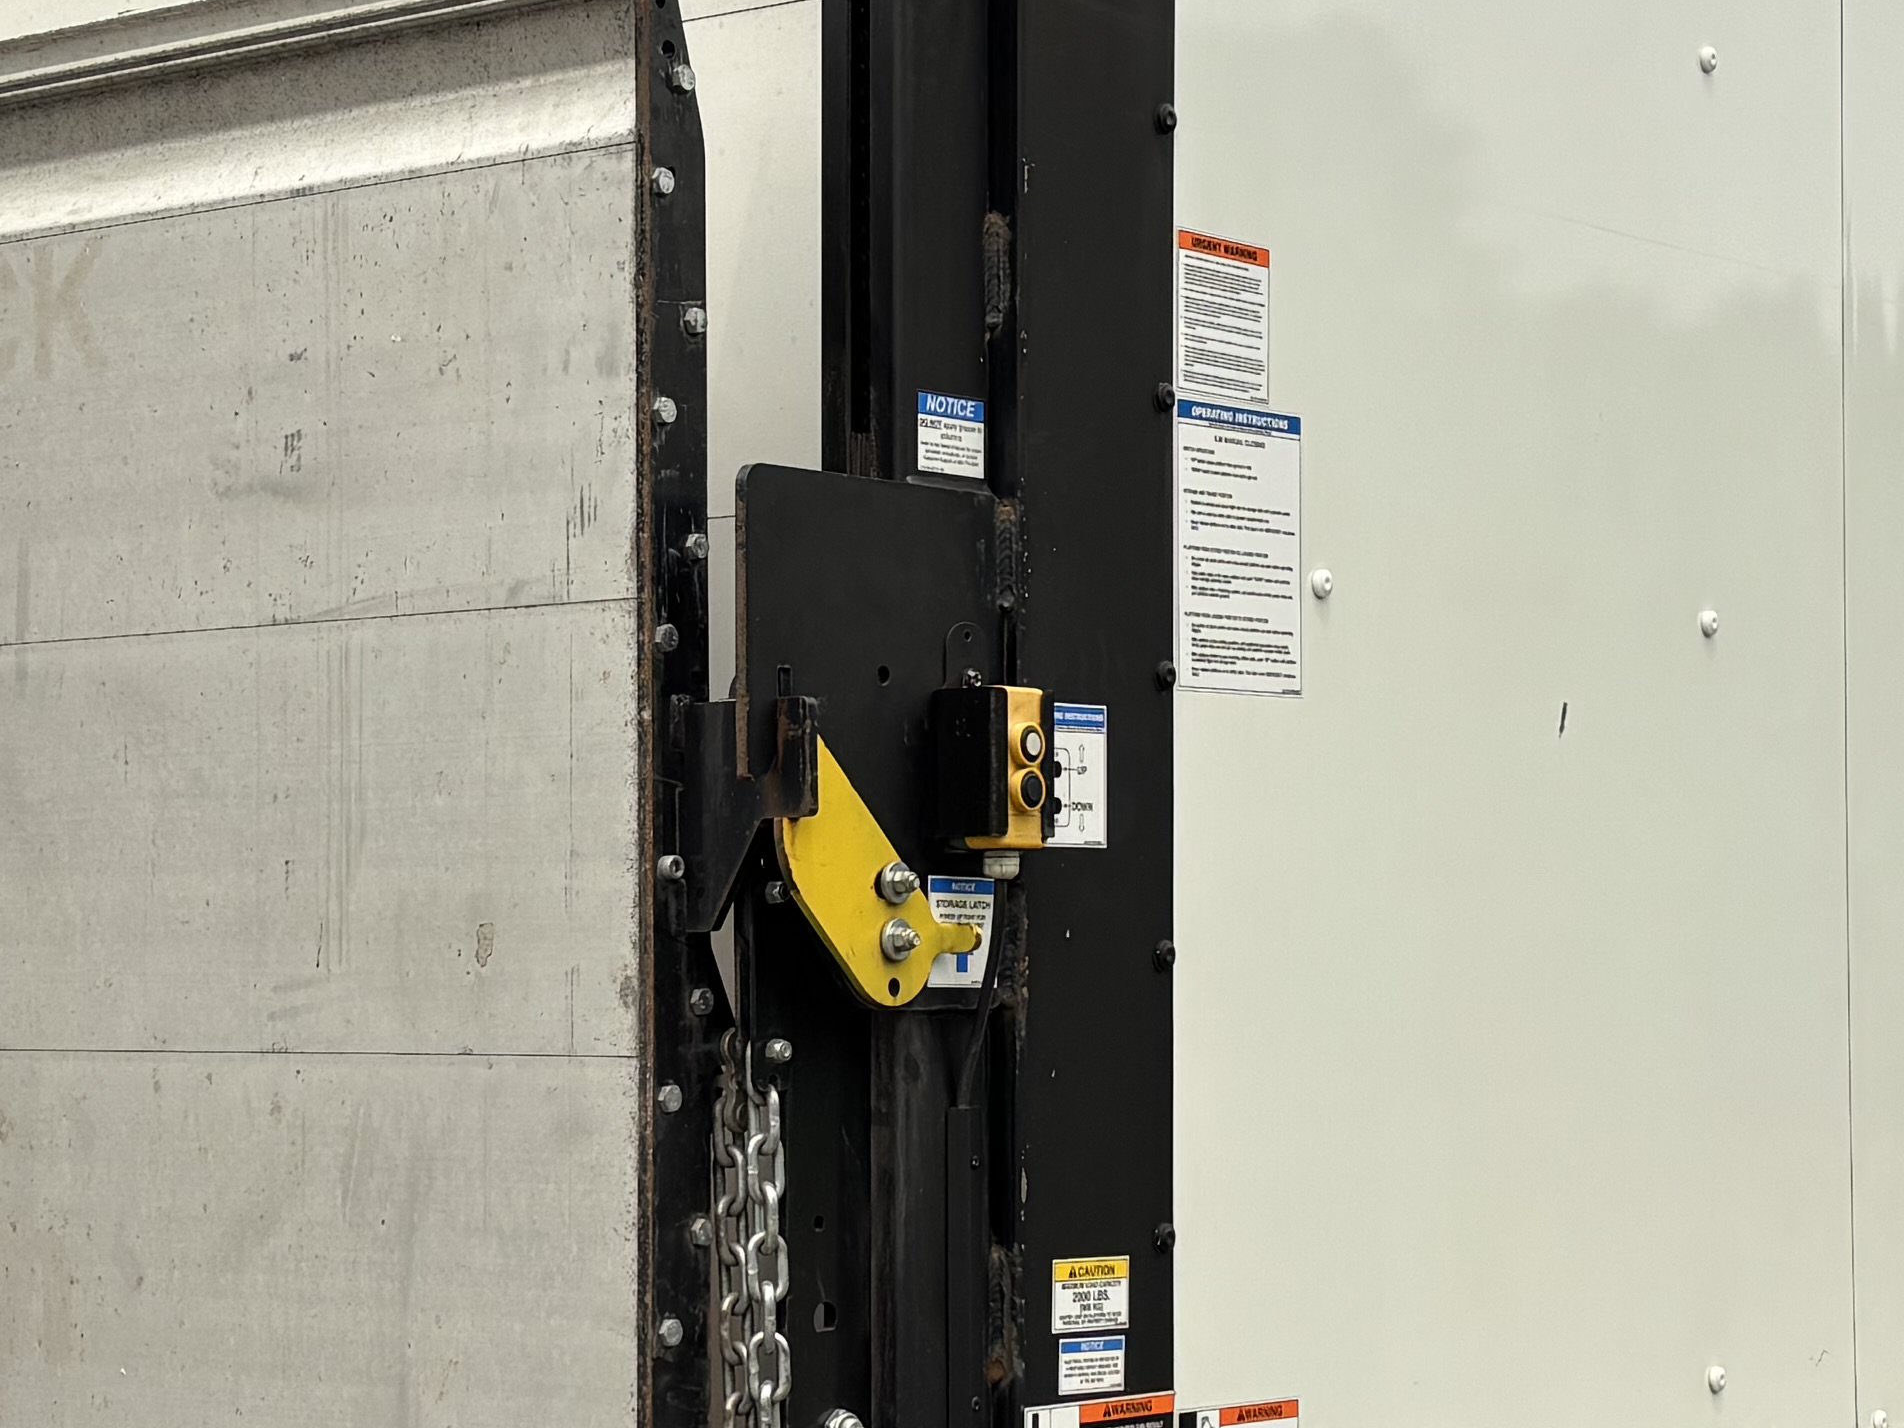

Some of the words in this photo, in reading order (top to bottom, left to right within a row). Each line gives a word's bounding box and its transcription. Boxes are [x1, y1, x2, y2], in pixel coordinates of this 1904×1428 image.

[1191, 237, 1222, 254] URGENT
[1224, 244, 1258, 262] WARNING
[926, 393, 976, 418] NOTICE
[1191, 406, 1234, 423] OPERATING
[1235, 412, 1289, 430] INSTRUCTIONS
[1071, 801, 1094, 812] DOWN
[968, 900, 991, 909] LATCH
[1078, 1265, 1115, 1277] CAUTION
[1112, 1400, 1153, 1415] WARNING
[1245, 1405, 1283, 1419] WARNING
